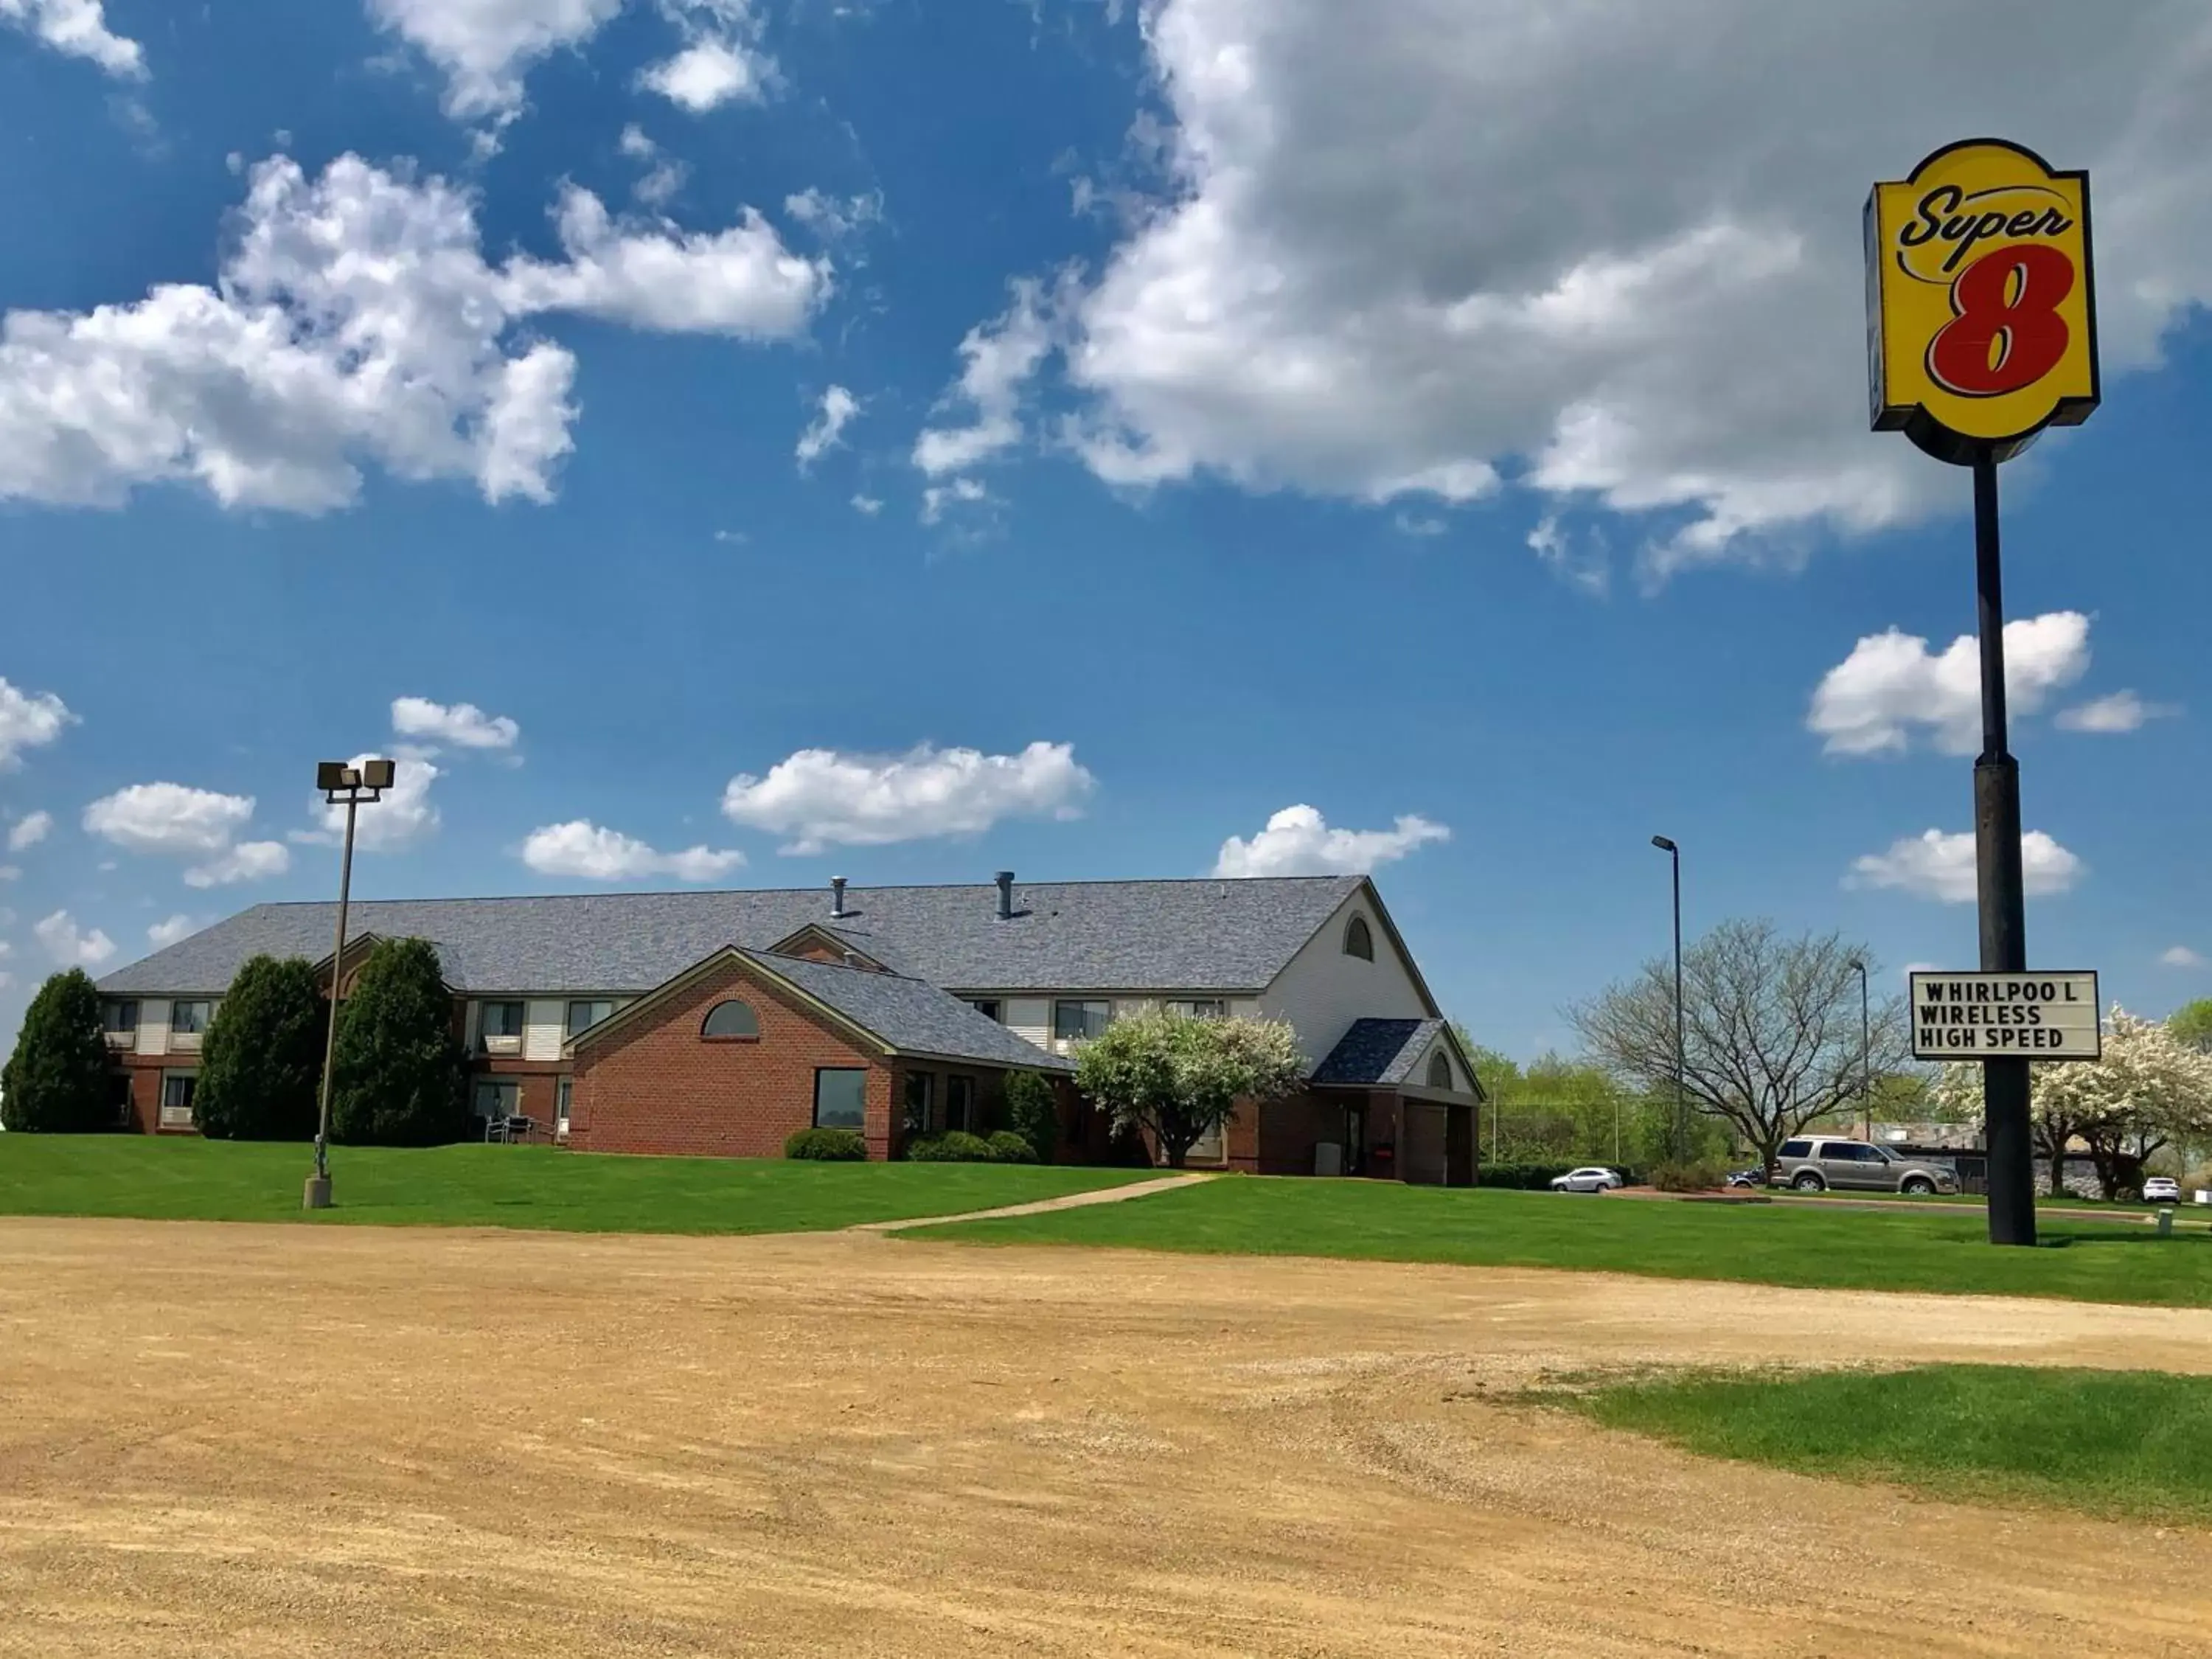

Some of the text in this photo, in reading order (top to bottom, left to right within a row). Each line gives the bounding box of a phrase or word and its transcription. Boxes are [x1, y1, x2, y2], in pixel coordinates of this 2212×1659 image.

[1899, 184, 2074, 272] Super
[1924, 243, 2075, 398] 8
[1920, 1005, 2041, 1025] WIRELESS
[1920, 1028, 2063, 1048] HIGH SPEED
